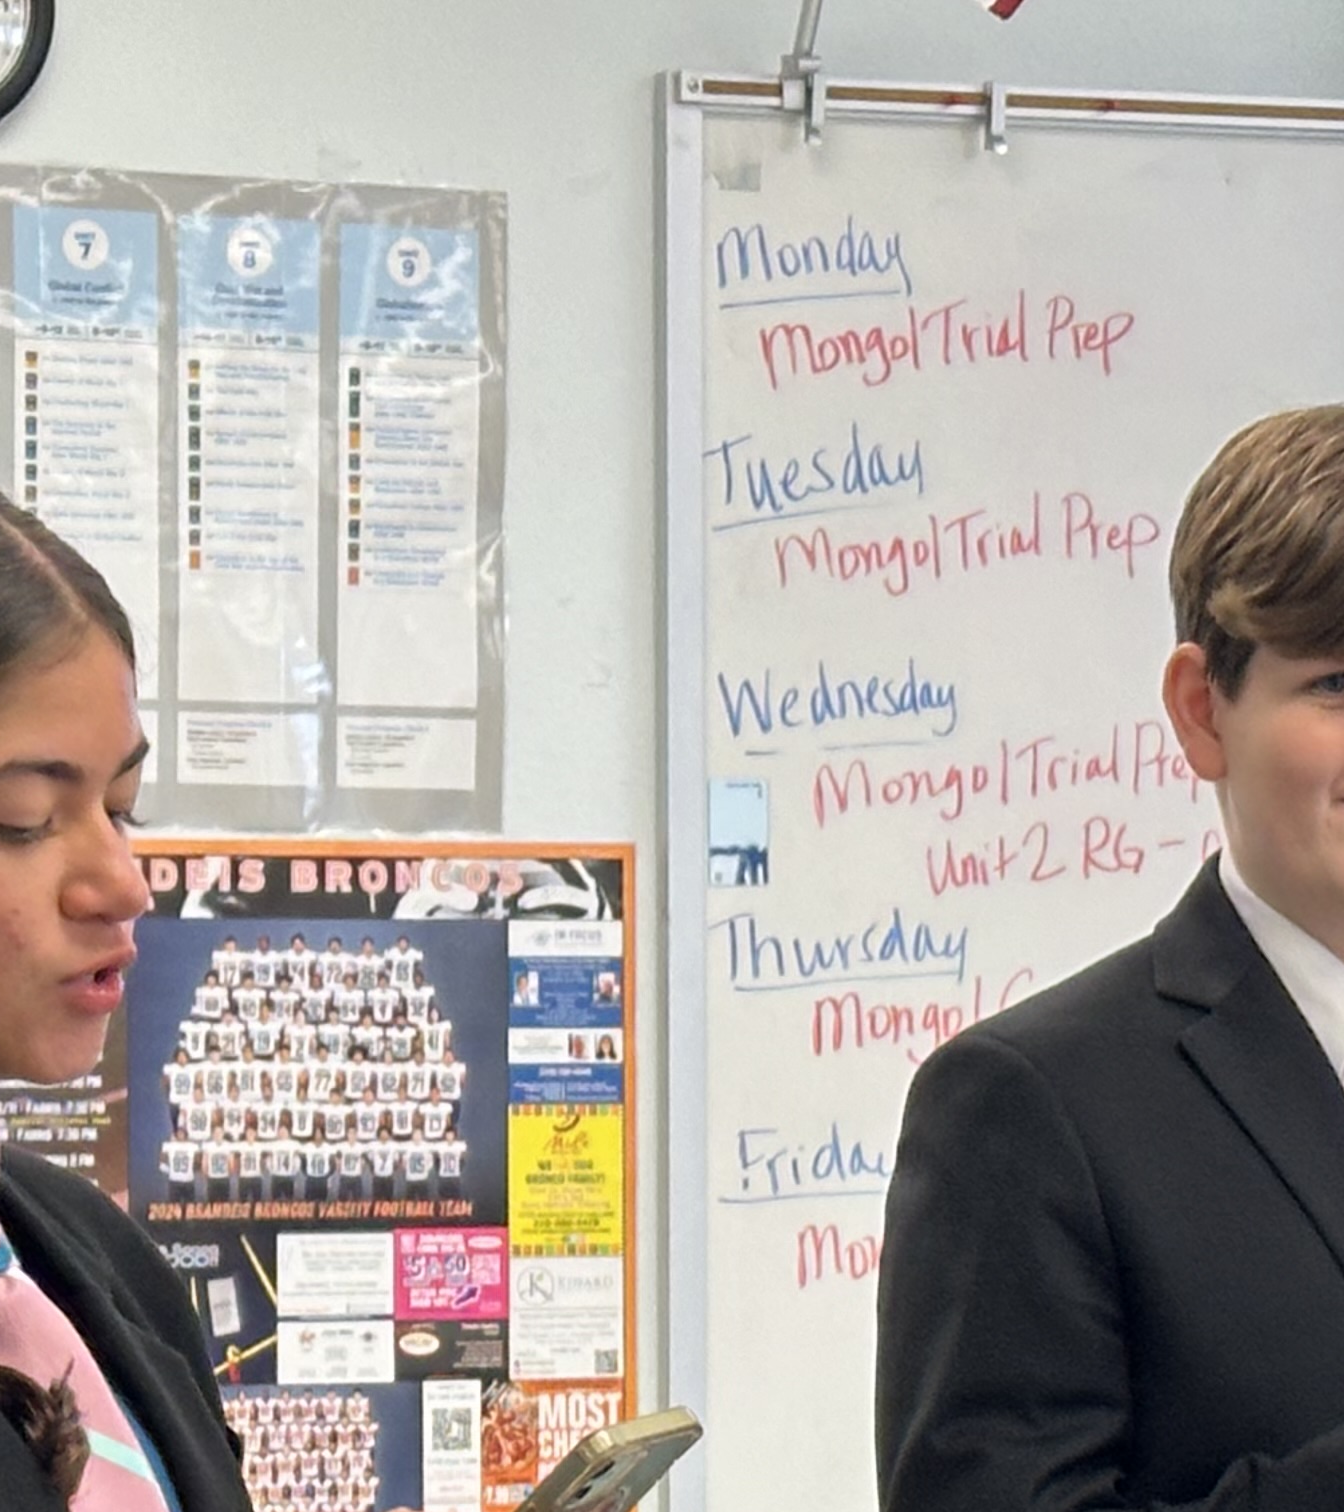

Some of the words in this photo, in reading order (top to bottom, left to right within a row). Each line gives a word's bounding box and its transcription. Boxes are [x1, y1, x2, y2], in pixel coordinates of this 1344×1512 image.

[77, 242, 92, 261] 7
[242, 249, 256, 269] 8
[402, 259, 415, 278] 9
[717, 215, 912, 297] Monday
[759, 305, 920, 391] Mongol
[921, 289, 1028, 364] Trial
[1045, 294, 1135, 375] Prep
[703, 421, 924, 511] Tuesday
[774, 513, 942, 597] Mongol
[943, 490, 1041, 571] Trial
[1060, 491, 1159, 579] Prep
[718, 658, 958, 738] Wednesday
[812, 739, 1009, 830] Mongol
[1016, 724, 1120, 797] Trial
[290, 858, 524, 894] BRONCOS
[924, 836, 1015, 896] Unit
[1023, 822, 1067, 882] 2
[708, 907, 969, 987] Thursday
[537, 1391, 622, 1428] MOST
